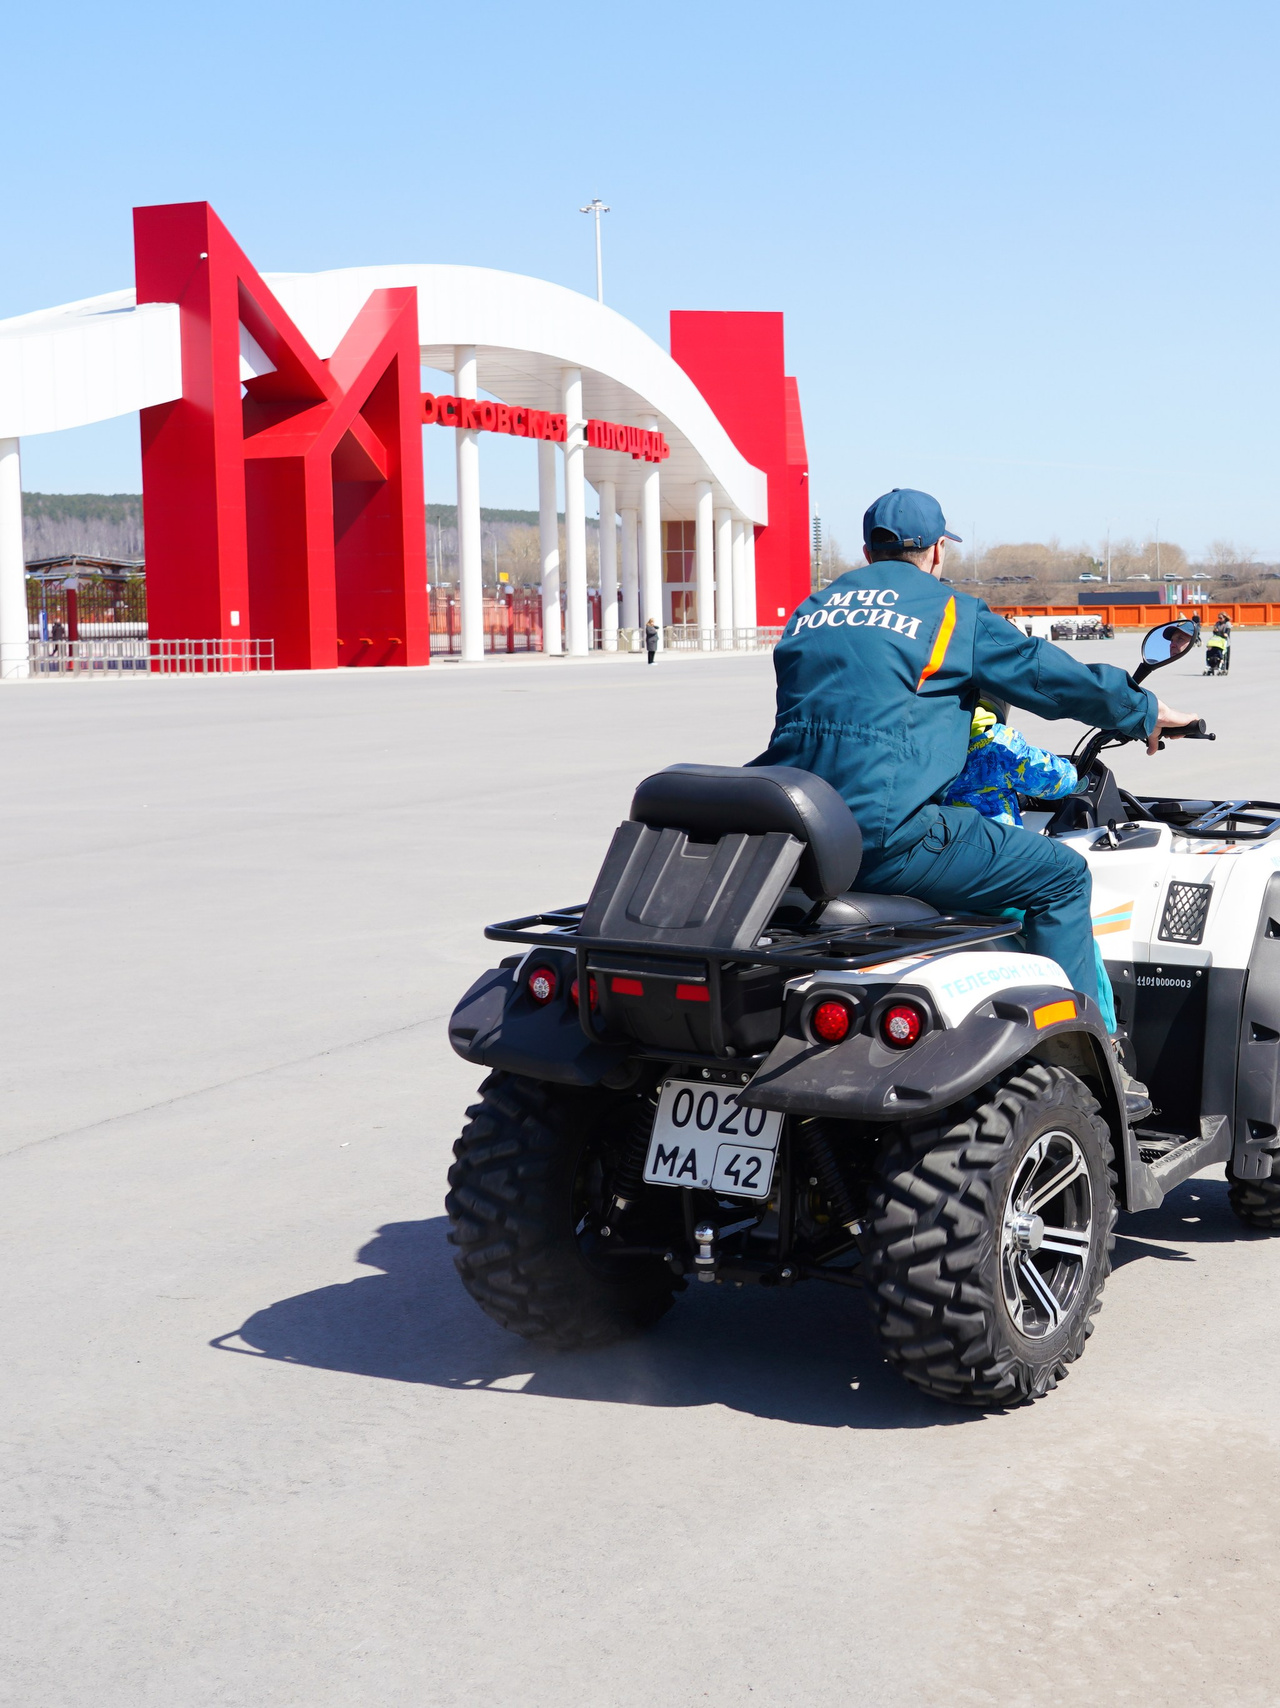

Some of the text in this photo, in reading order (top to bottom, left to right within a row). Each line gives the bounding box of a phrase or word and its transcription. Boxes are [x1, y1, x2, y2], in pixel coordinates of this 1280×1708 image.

[588, 418, 670, 464] ПЛОЩАДЬ
[823, 589, 899, 607] МЧС
[791, 608, 923, 640] РОССИИ
[941, 965, 1021, 999] ТЕЛЕФОН
[1021, 963, 1045, 977] 112
[671, 1087, 767, 1138] 0020
[651, 1143, 698, 1181] МА
[723, 1153, 763, 1189] 42
